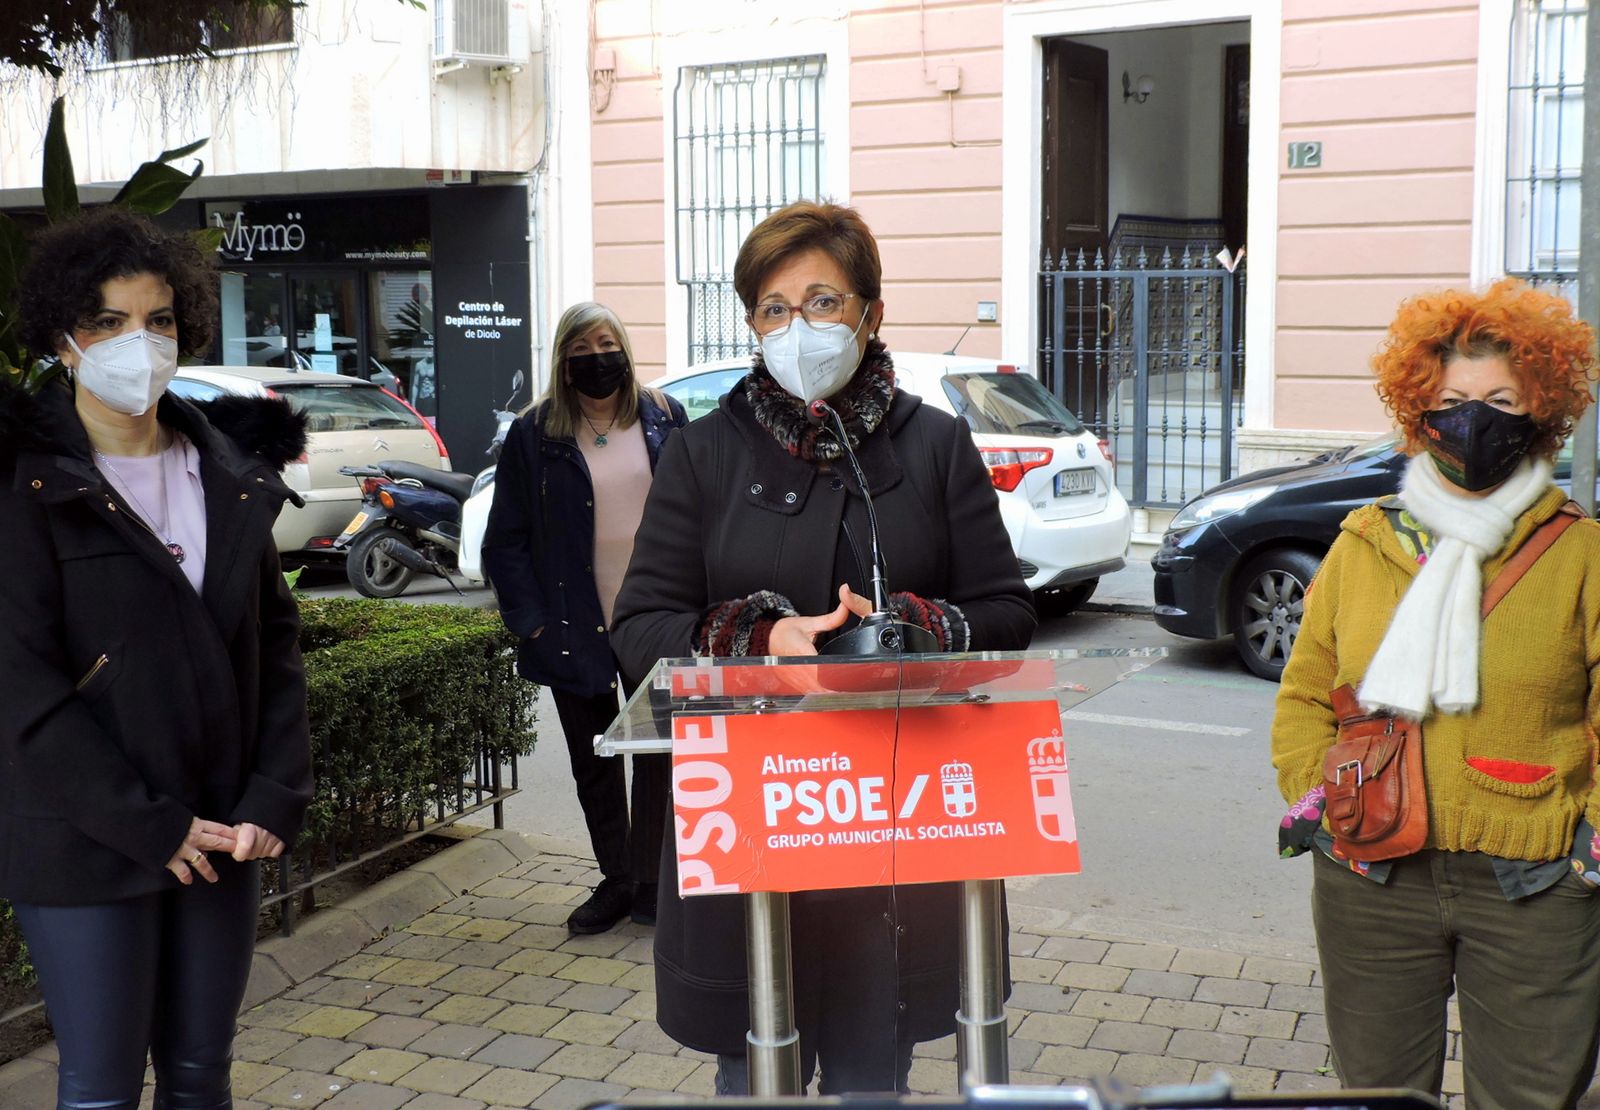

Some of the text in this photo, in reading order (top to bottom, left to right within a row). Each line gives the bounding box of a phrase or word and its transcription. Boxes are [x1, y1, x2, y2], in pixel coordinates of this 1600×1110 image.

[1290, 142, 1318, 168] 12
[213, 211, 305, 261] Mymö
[345, 251, 427, 260] www.mymobeauty.com
[459, 301, 505, 312] Centro de
[445, 315, 522, 328] Depilación Láser
[465, 329, 500, 339] de Diodo
[761, 751, 851, 776] Almería
[673, 715, 740, 894] PSOE
[763, 776, 888, 827] PSOE
[767, 821, 1006, 849] GRUPO MUNICIPAL SOCIALISTA
